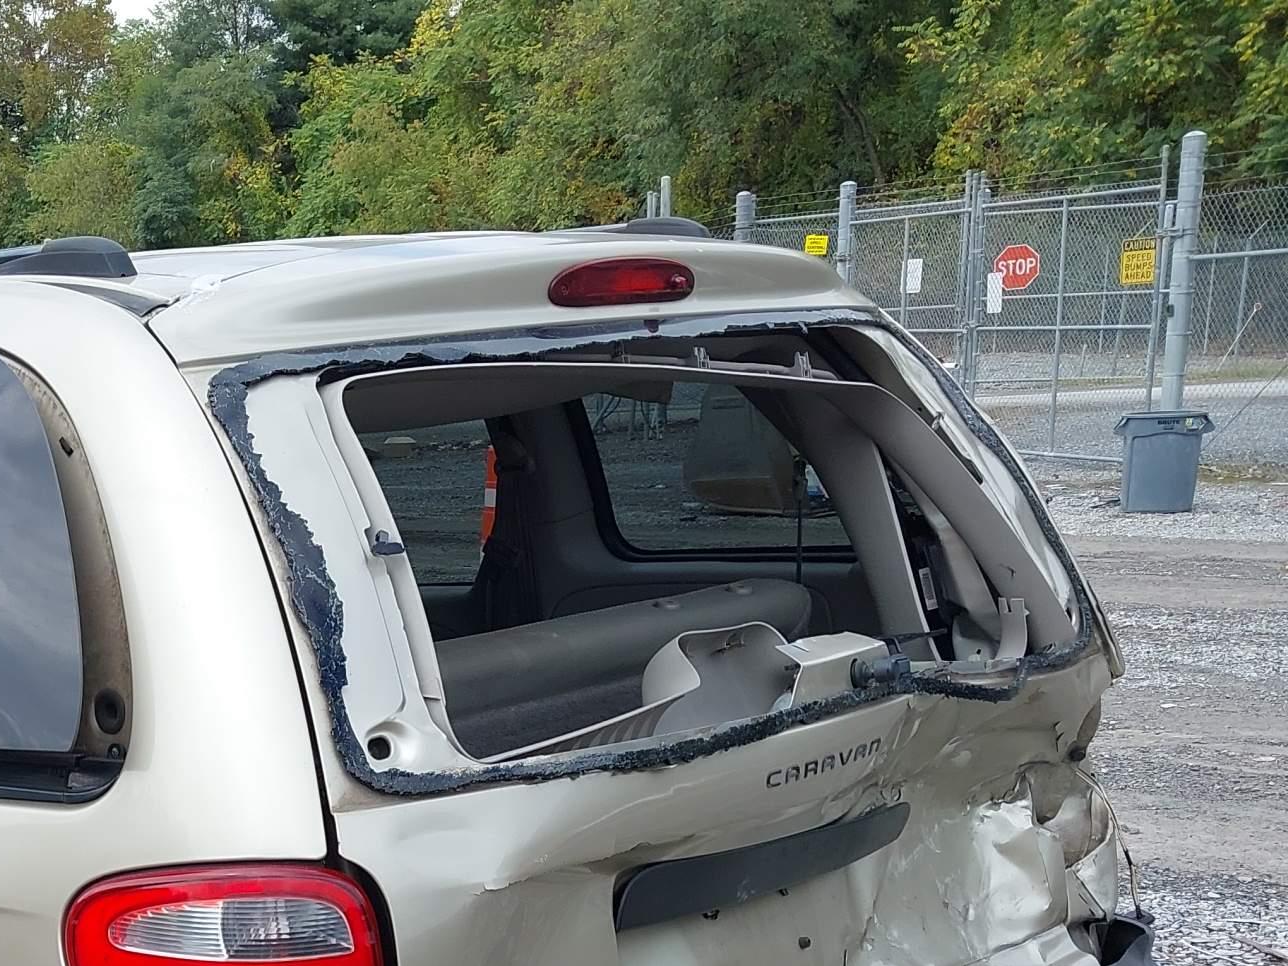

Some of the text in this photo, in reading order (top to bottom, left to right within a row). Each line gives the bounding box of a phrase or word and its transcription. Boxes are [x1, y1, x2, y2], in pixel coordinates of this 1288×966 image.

[1124, 239, 1155, 250] CAUTION
[1126, 252, 1152, 262] SPEED
[998, 257, 1036, 278] STOP
[1124, 261, 1153, 272] BUMPS
[1124, 270, 1152, 281] AHEAD
[766, 737, 882, 789] CARAVAN
